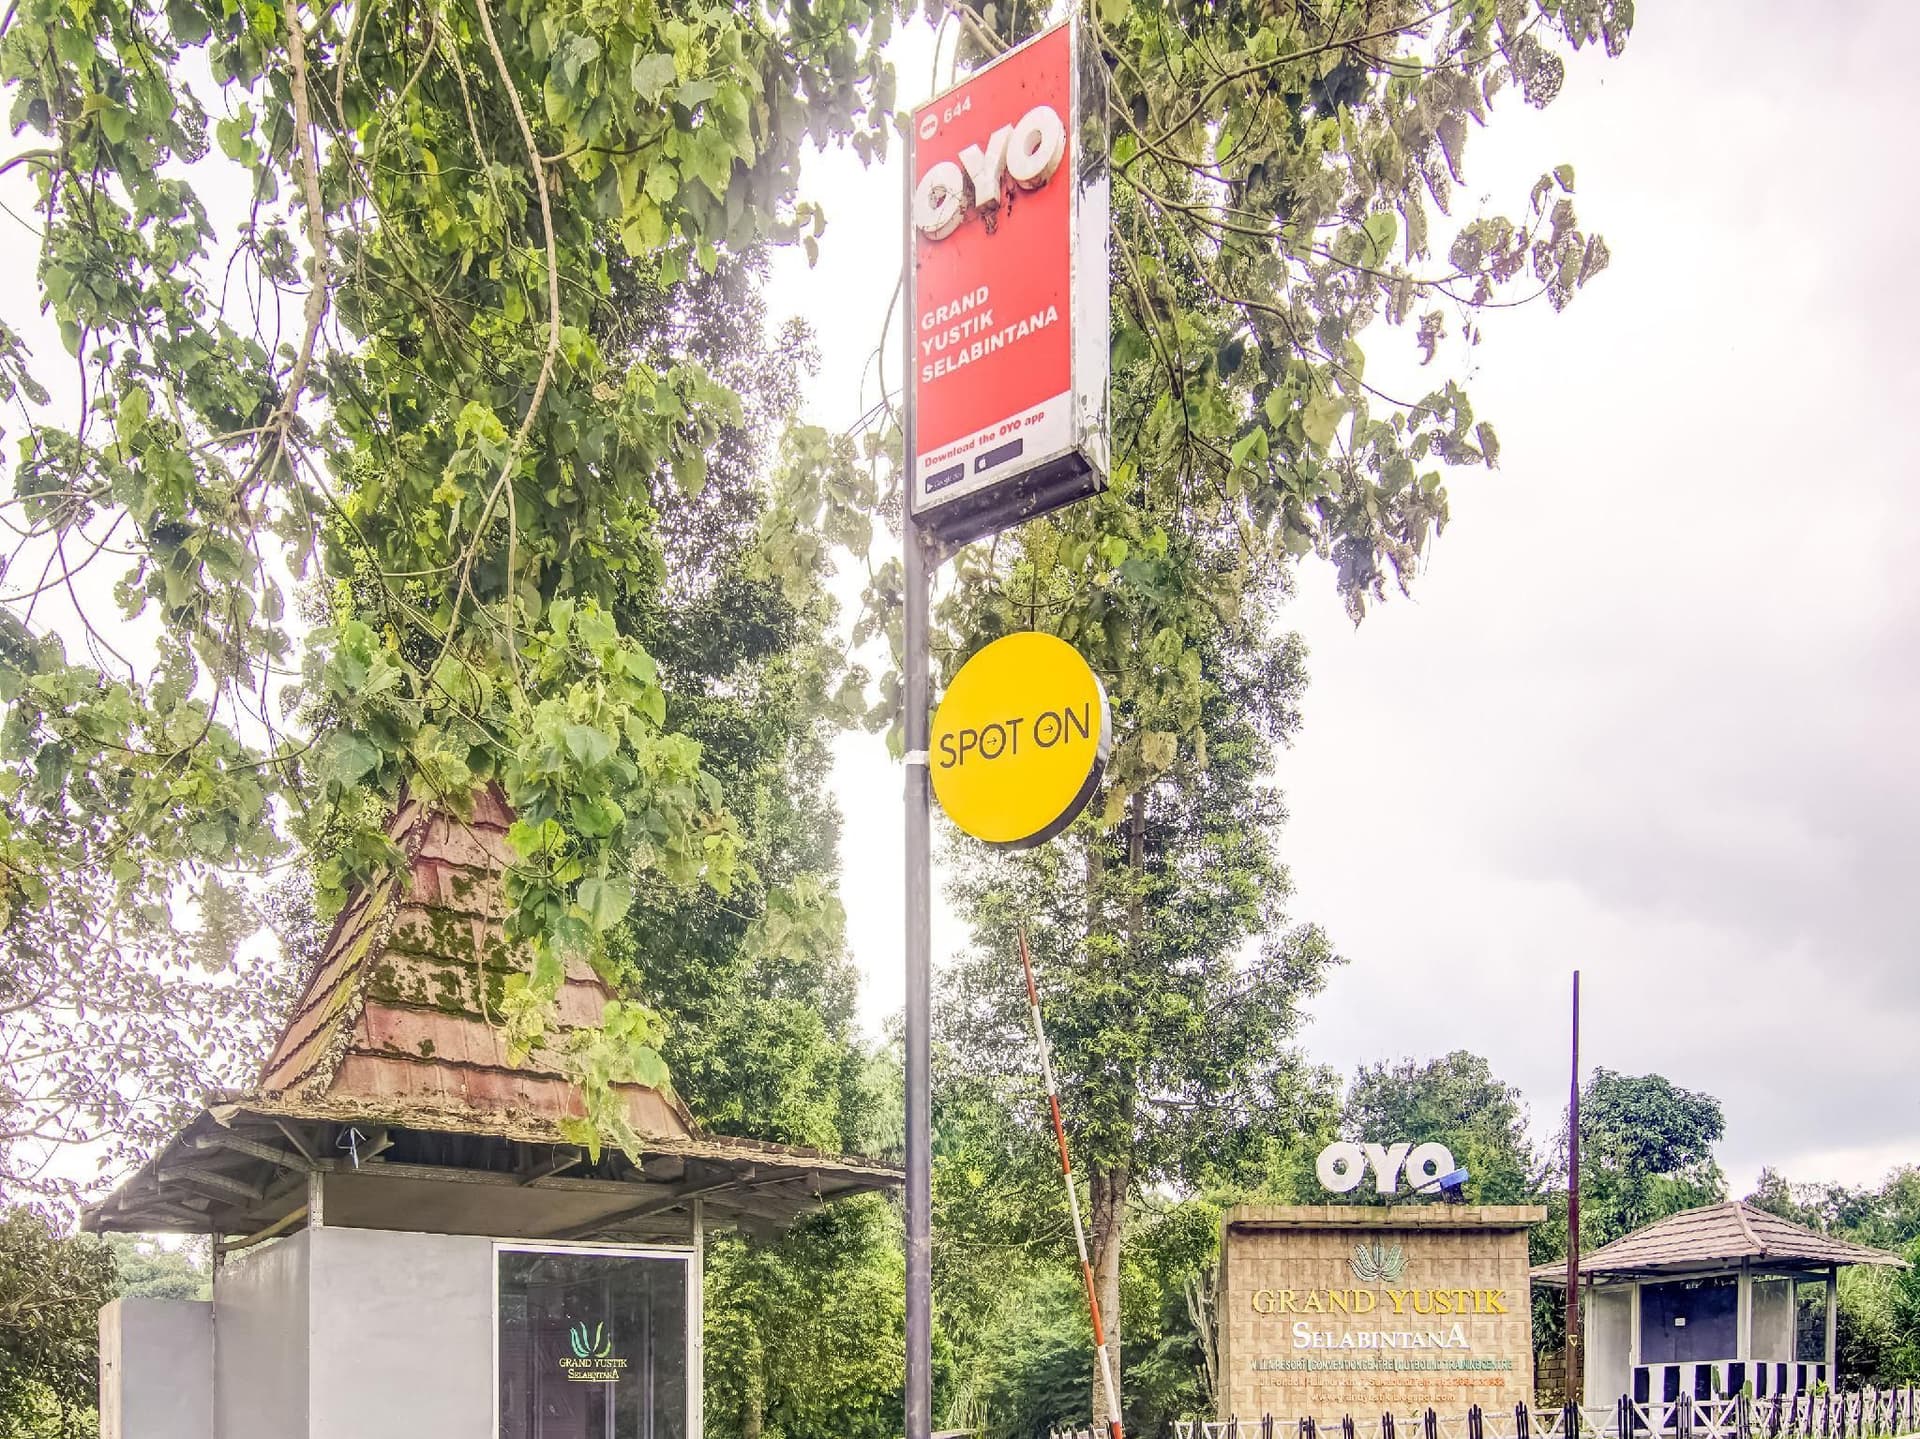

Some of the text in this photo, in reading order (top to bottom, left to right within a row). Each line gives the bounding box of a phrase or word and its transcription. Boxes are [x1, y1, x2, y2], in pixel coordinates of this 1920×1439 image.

[943, 96, 972, 124] 644
[912, 105, 1066, 241] OYO
[920, 309, 994, 357] YUSTIK
[921, 285, 990, 332] GRAND
[921, 305, 1059, 384] SELABINTANA
[924, 410, 1045, 468] Download the OYO app
[939, 702, 1090, 769] SPOT ON
[1315, 1141, 1456, 1194] OYO
[1252, 1289, 1509, 1314] GRAND YUSTIK
[559, 1357, 628, 1368] GRAND YUSTIK
